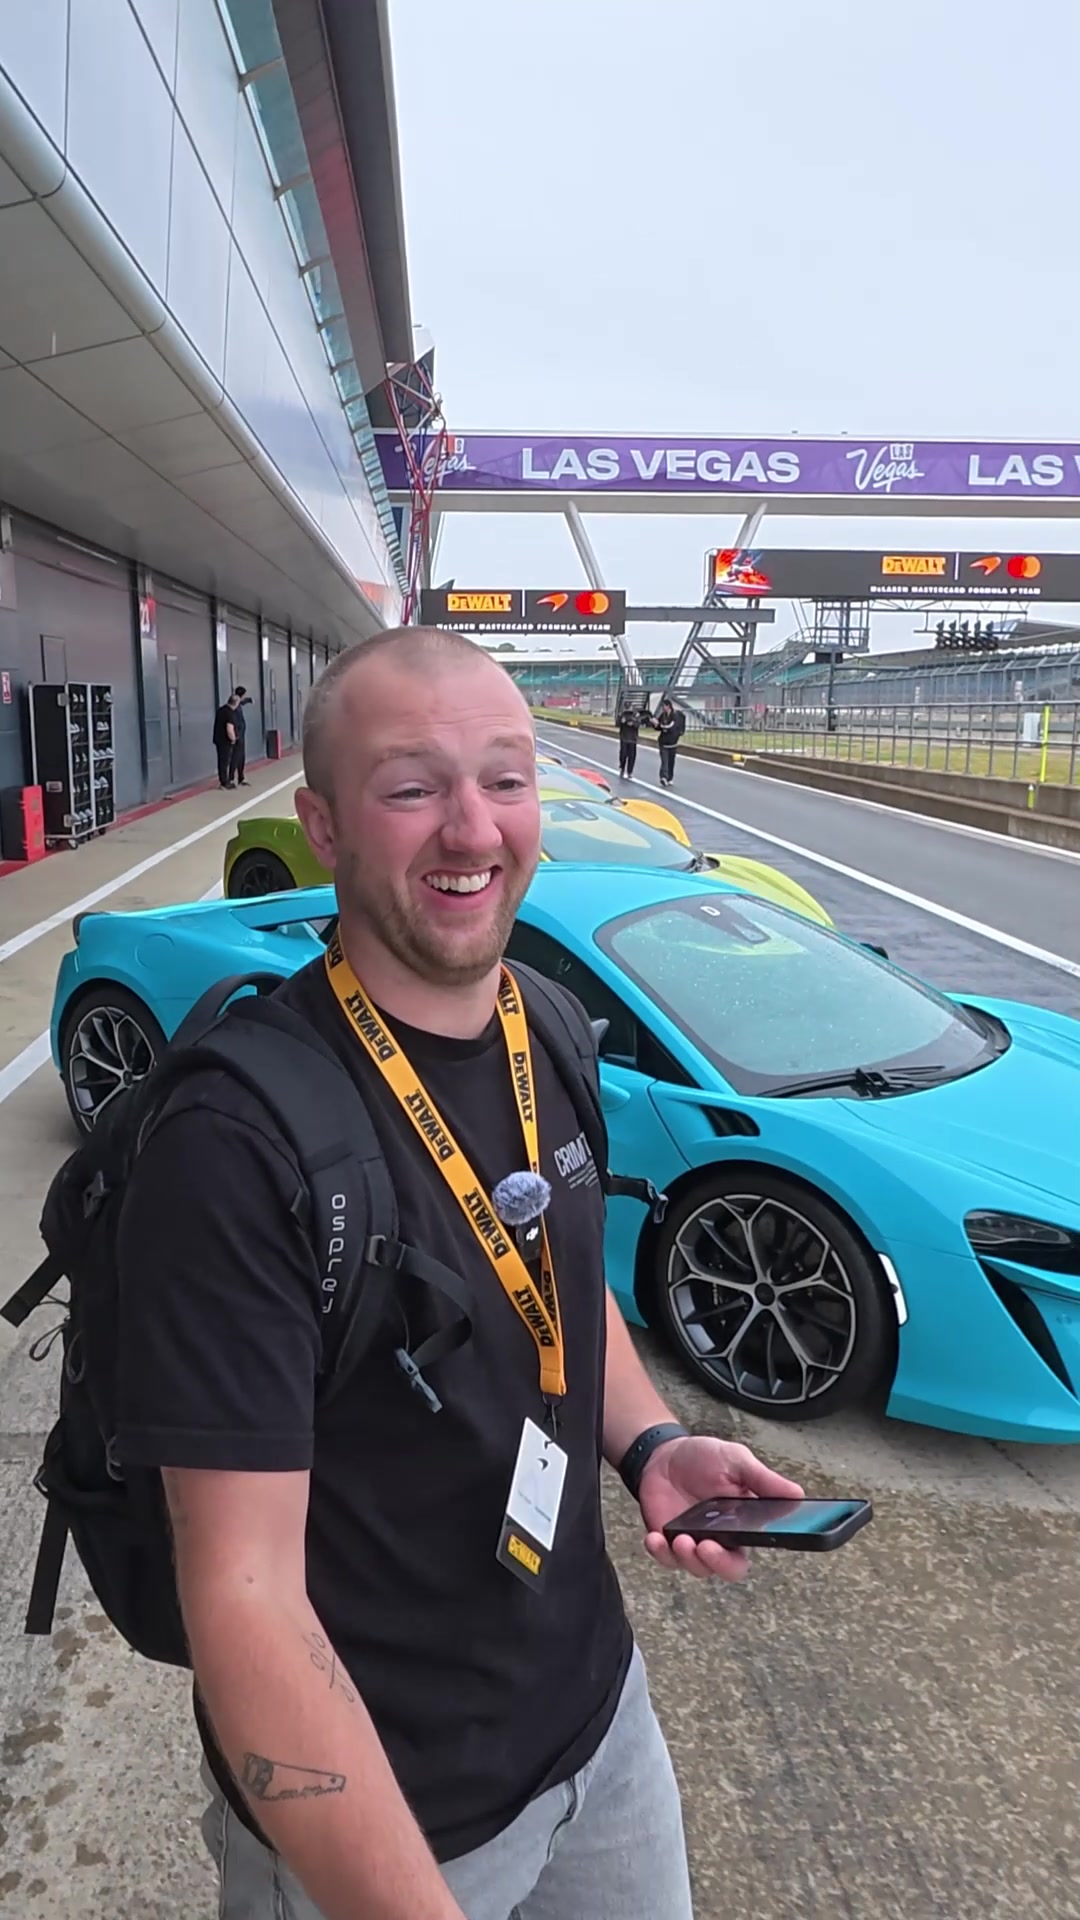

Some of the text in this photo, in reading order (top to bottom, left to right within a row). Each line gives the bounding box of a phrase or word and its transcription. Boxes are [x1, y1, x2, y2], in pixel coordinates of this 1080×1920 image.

[522, 447, 801, 483] LAS VEGAS
[846, 446, 925, 492] Vegas
[892, 444, 912, 458] LAS
[968, 454, 1064, 486] LAS
[884, 556, 946, 574] DEWALT
[449, 594, 511, 611] DEWALT
[911, 586, 966, 594] MASTERCARD
[968, 586, 1008, 594] FORMULA
[1018, 587, 1041, 595] TEAM
[478, 623, 534, 631] MASTERCARD
[536, 623, 577, 631] FORMULA
[588, 623, 611, 631] TEAM
[345, 990, 397, 1062] DEWALT
[512, 1051, 534, 1123] DEWALT
[403, 1088, 455, 1163] DEWALT
[462, 1187, 511, 1260] DEWALT
[512, 1284, 556, 1347] DEWALT
